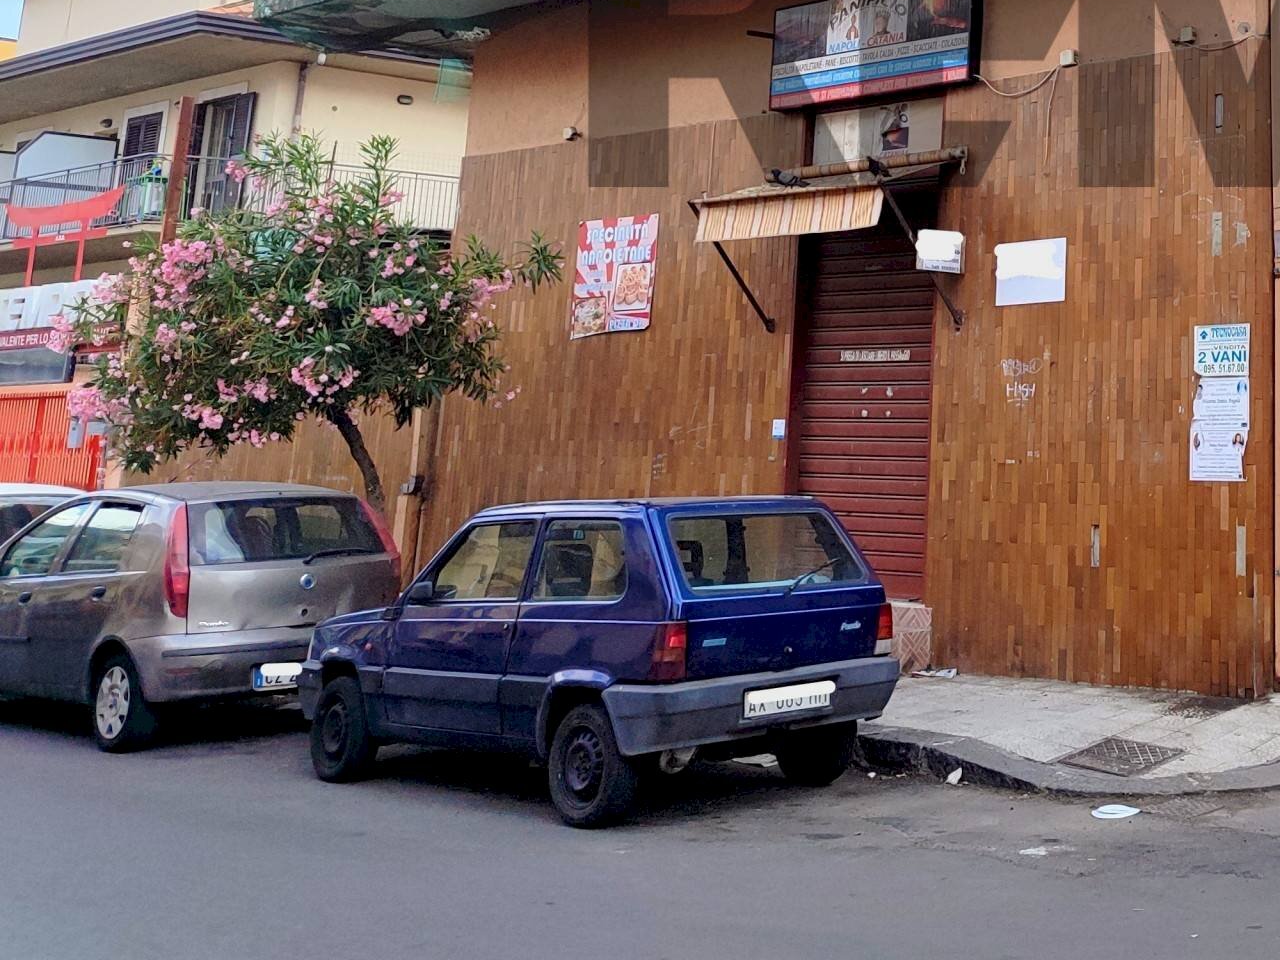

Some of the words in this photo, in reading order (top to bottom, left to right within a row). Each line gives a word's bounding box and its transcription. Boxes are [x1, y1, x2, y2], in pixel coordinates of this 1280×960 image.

[828, 38, 861, 54] NAPOLI
[866, 32, 905, 46] CATANIA
[26, 334, 38, 345] PER
[39, 333, 49, 344] LO
[1198, 351, 1207, 364] 2
[1211, 350, 1247, 363] VANI
